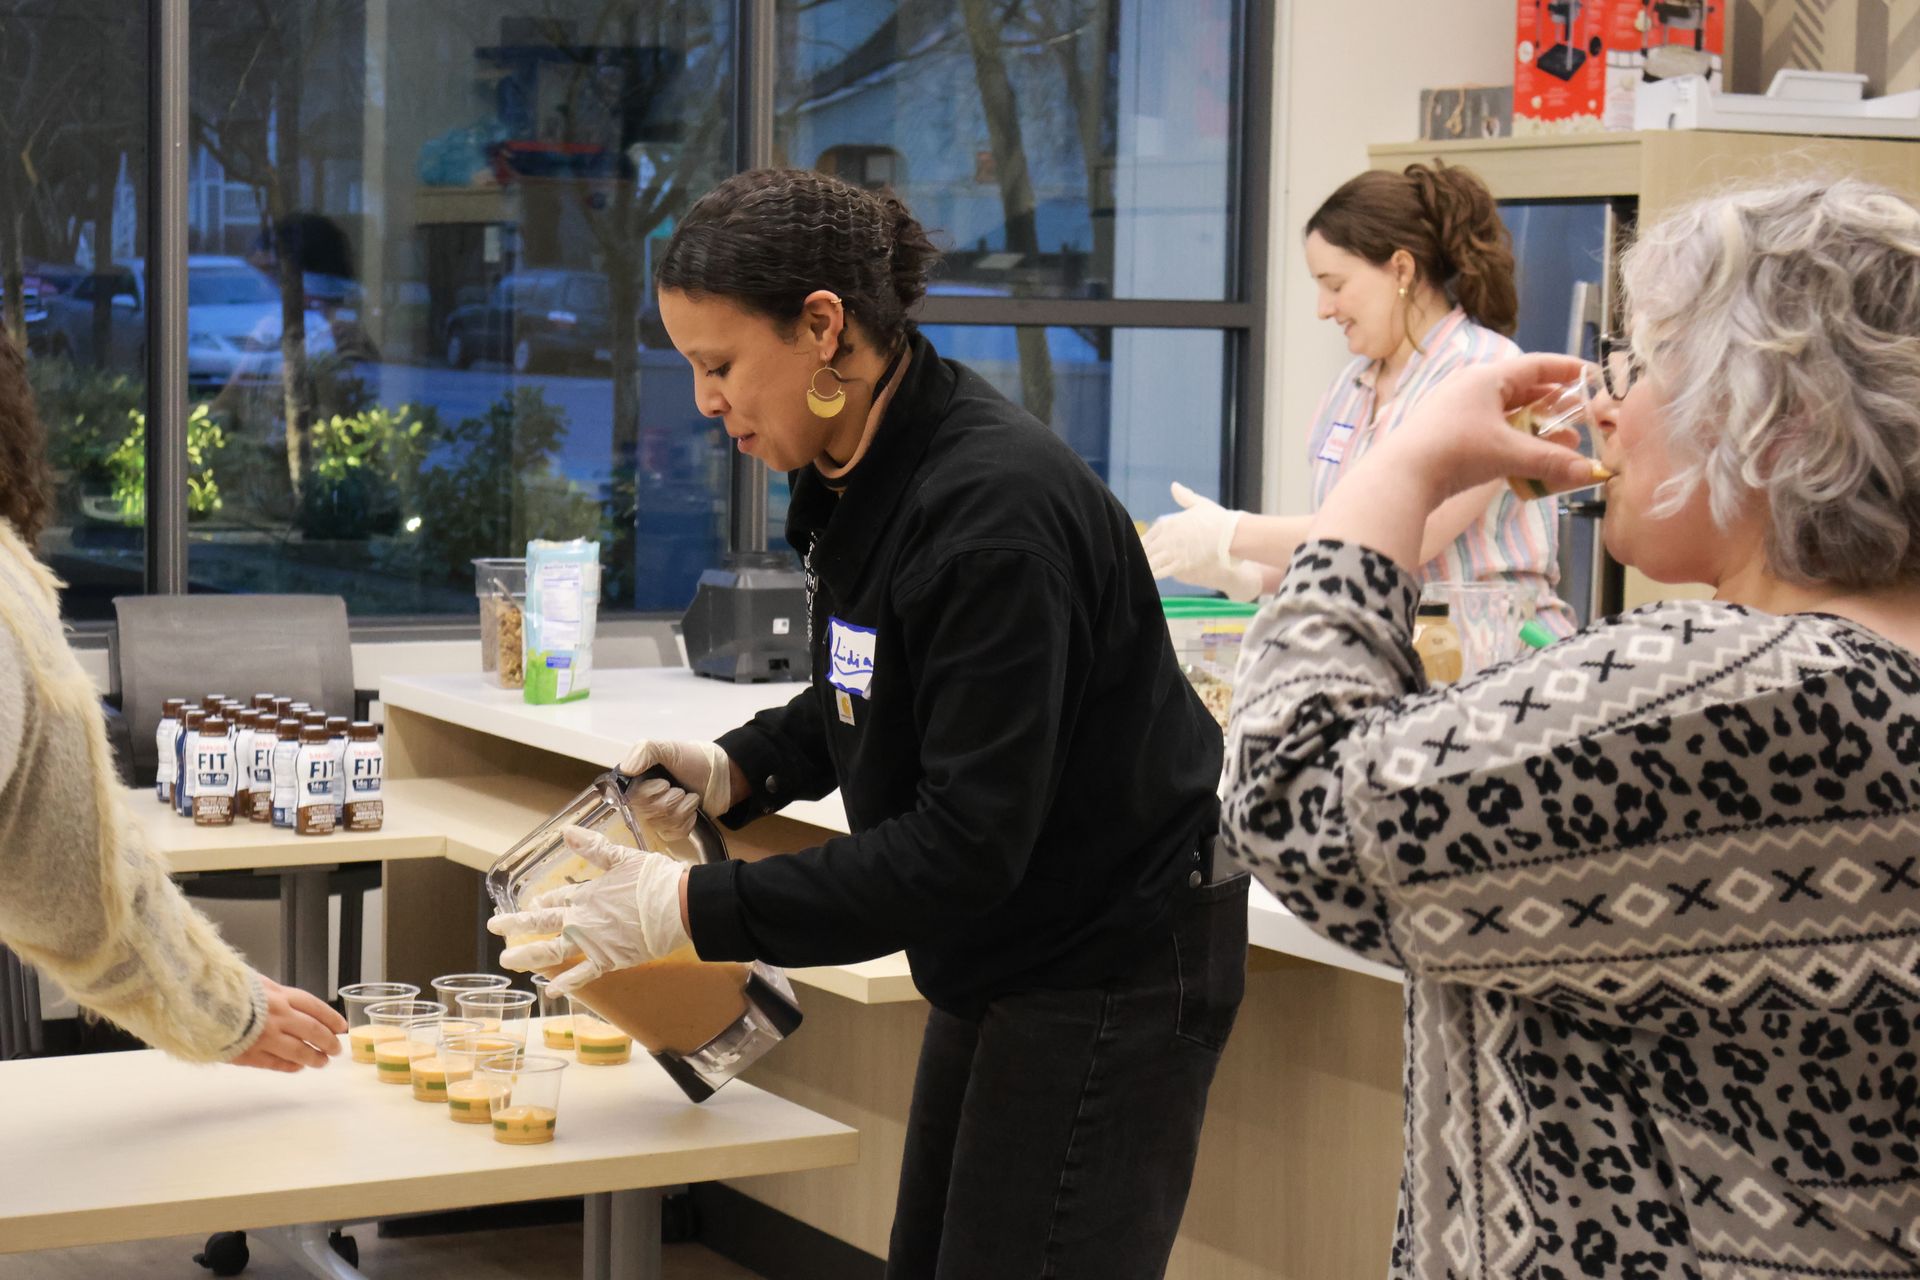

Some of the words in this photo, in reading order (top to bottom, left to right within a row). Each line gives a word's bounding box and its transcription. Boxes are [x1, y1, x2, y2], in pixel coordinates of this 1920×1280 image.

[834, 636, 873, 668] Lidia
[198, 753, 227, 770] FIT
[255, 749, 270, 767] FI
[354, 757, 381, 775] FIT
[310, 760, 334, 778] FIT
